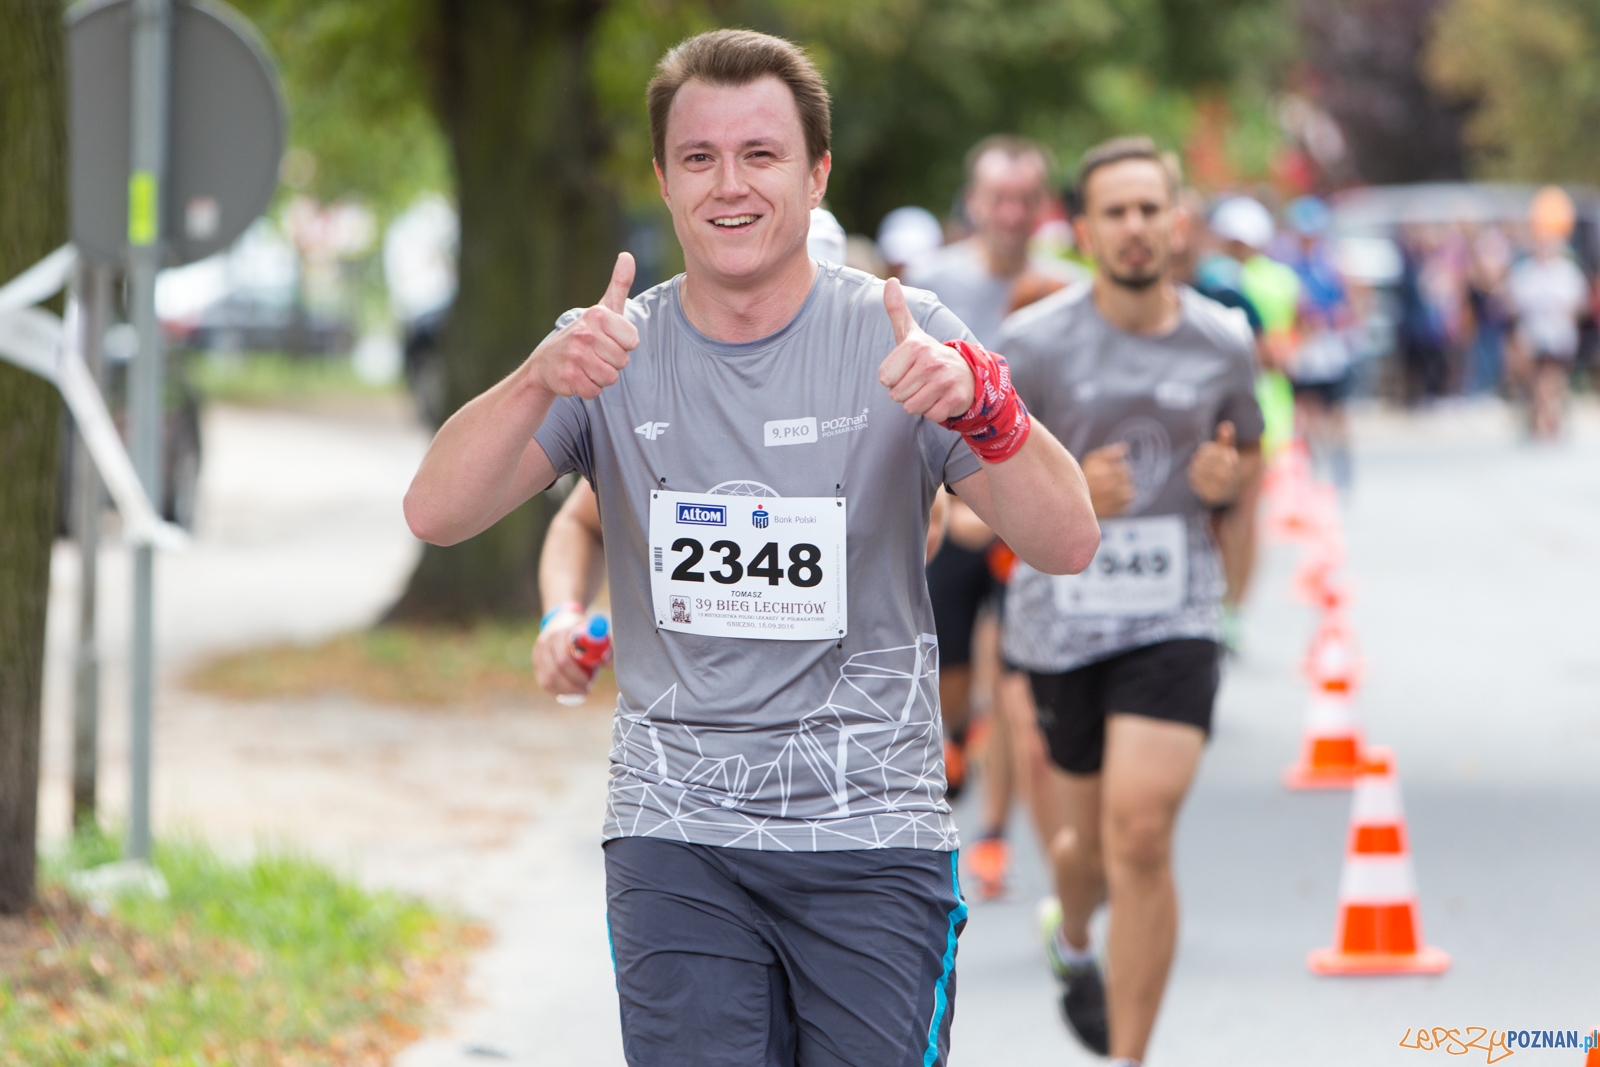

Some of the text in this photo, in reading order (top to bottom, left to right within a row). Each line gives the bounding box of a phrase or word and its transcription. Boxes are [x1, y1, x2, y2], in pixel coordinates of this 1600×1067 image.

[634, 421, 670, 440] 4F
[772, 425, 809, 439] 9. PKO
[774, 515, 793, 524] Bank
[795, 515, 817, 524] Polski
[670, 537, 823, 588] 2348
[731, 590, 762, 599] TOMASZ
[695, 598, 827, 614] 39 BIEG LECHITÓW
[726, 621, 795, 630] GNIEZNO, 18.09.2016
